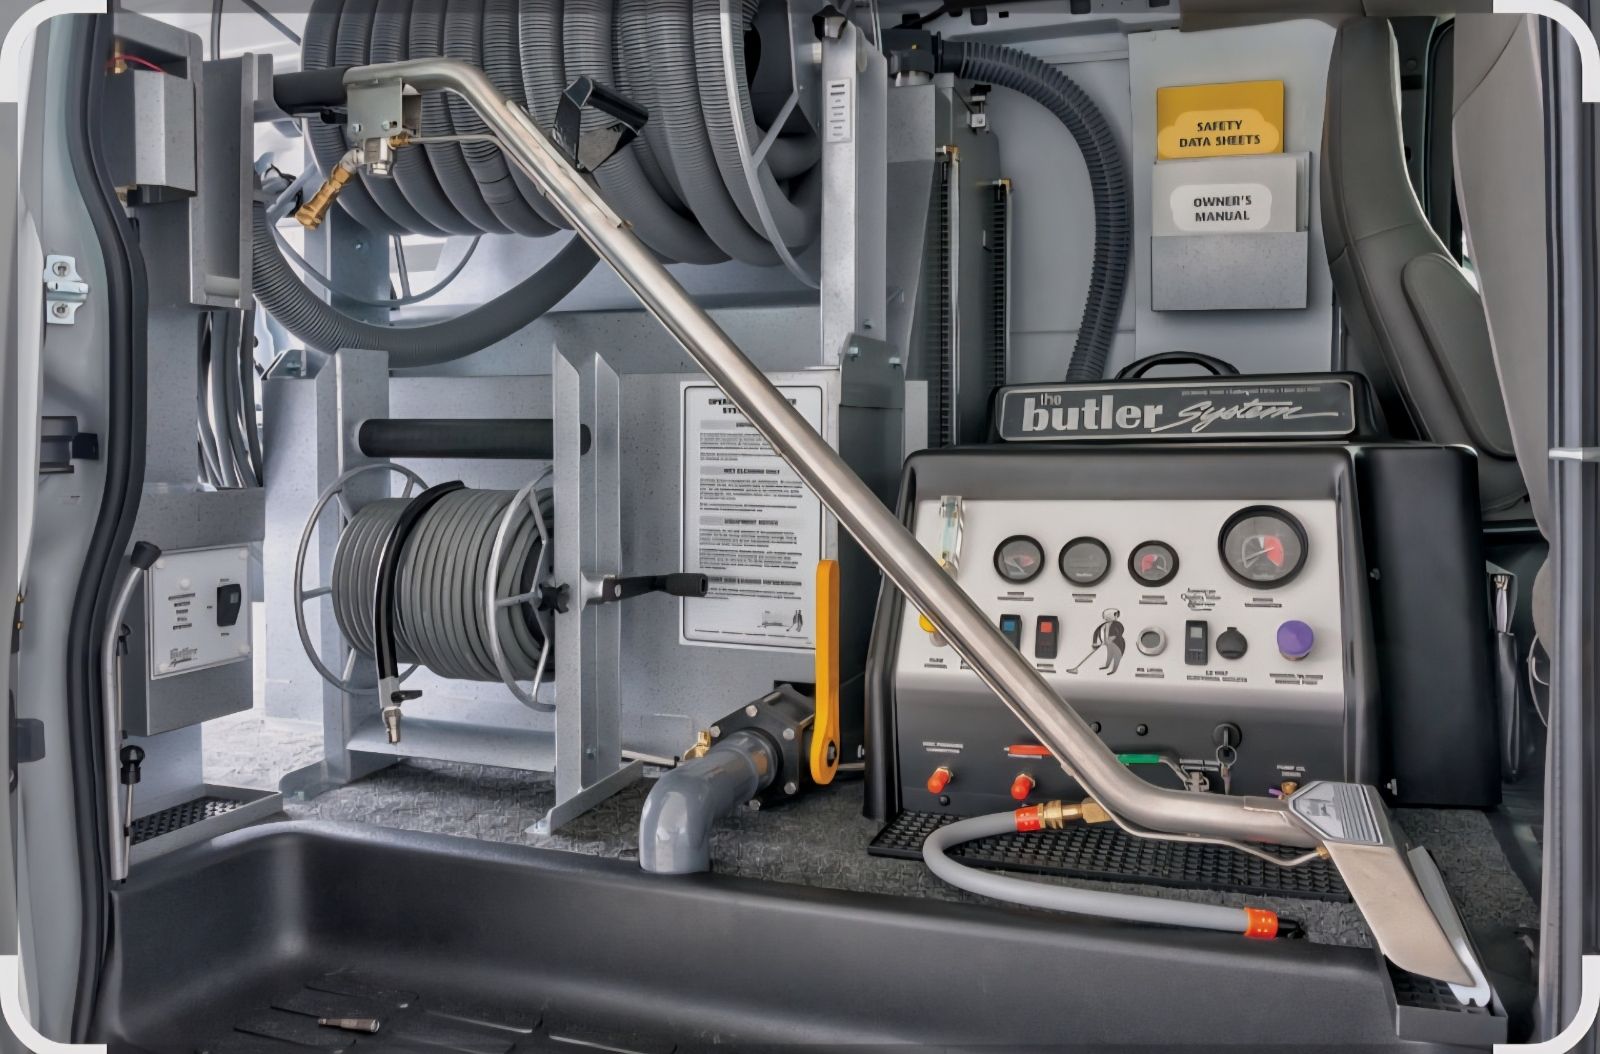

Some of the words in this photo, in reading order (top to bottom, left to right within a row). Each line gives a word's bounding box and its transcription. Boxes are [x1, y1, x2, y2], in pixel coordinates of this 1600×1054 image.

[1197, 120, 1243, 132] SAFETY
[1179, 136, 1211, 148] DATA
[1216, 134, 1261, 146] SHEETS
[1193, 195, 1252, 208] OWNER'S
[1195, 210, 1250, 222] MANUAL
[1040, 393, 1062, 406] the
[1022, 395, 1164, 432] butler
[1151, 398, 1339, 433] System
